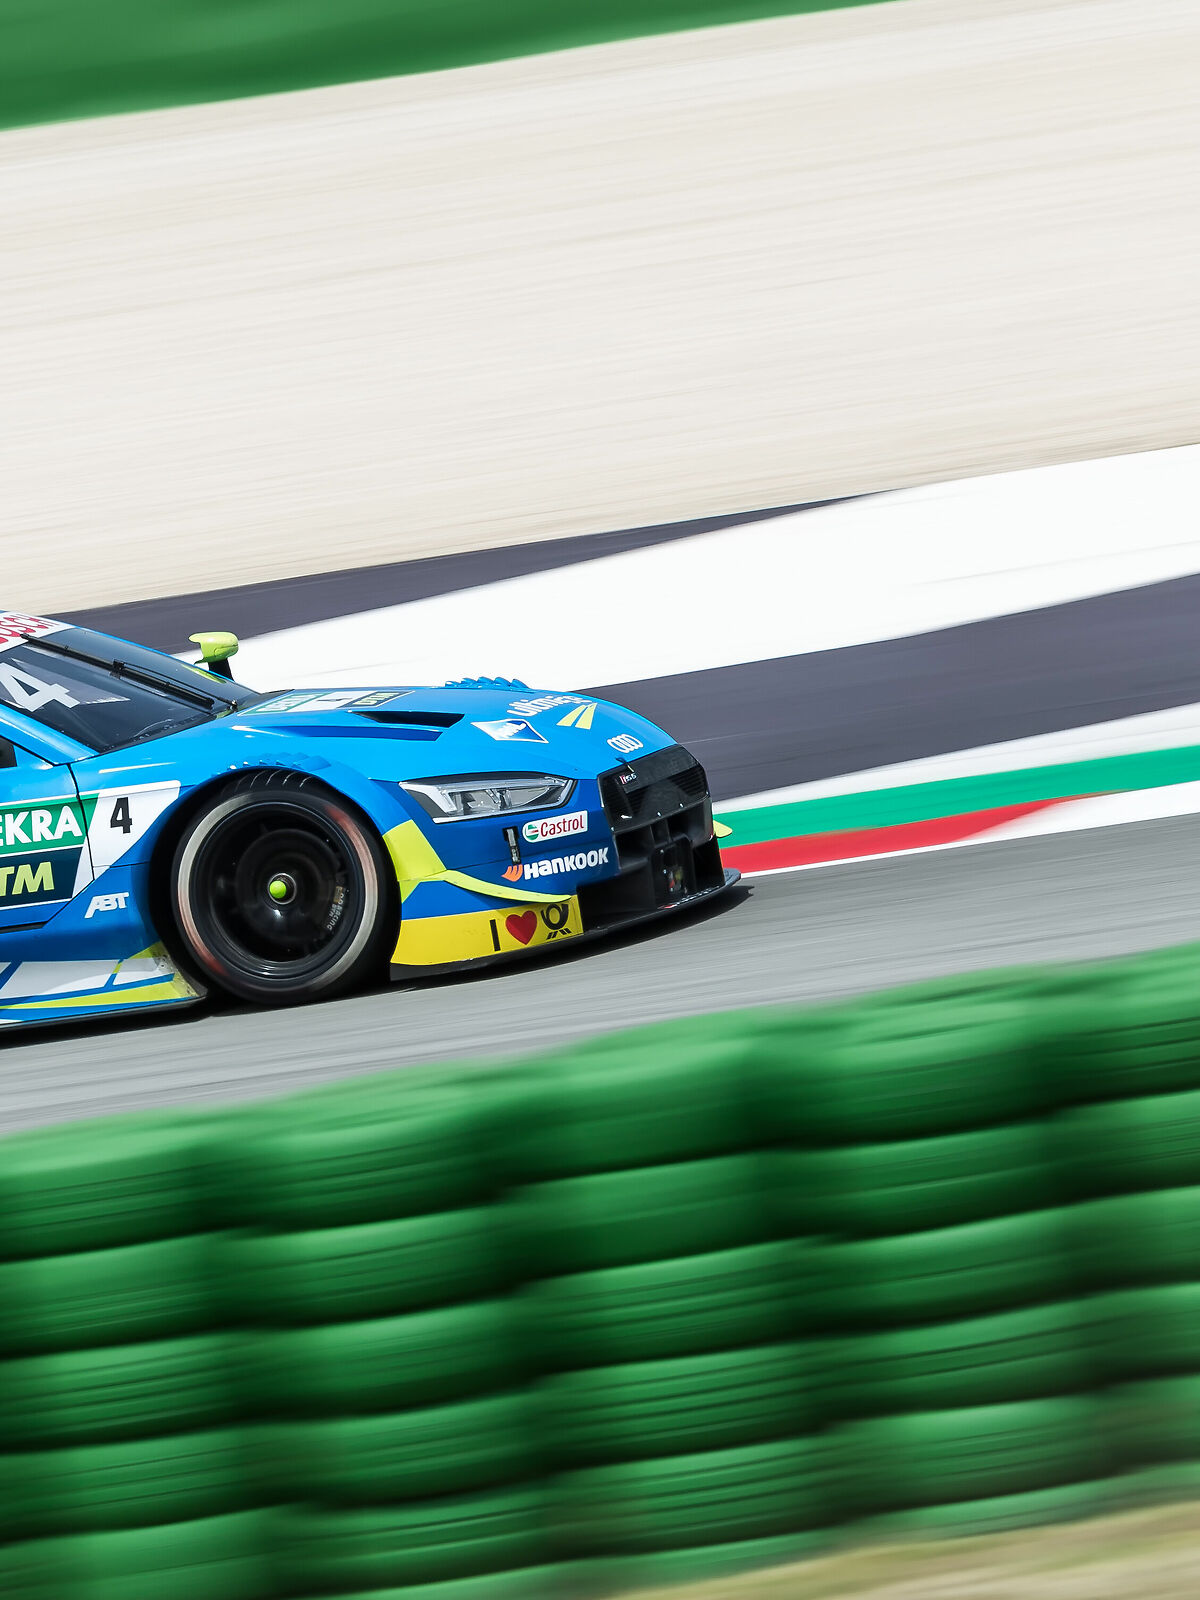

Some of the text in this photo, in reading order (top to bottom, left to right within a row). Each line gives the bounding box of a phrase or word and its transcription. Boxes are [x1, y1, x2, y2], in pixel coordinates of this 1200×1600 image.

[109, 796, 133, 835] 4
[540, 815, 585, 838] Castrol
[84, 892, 130, 919] ABT
[489, 918, 501, 952] I
